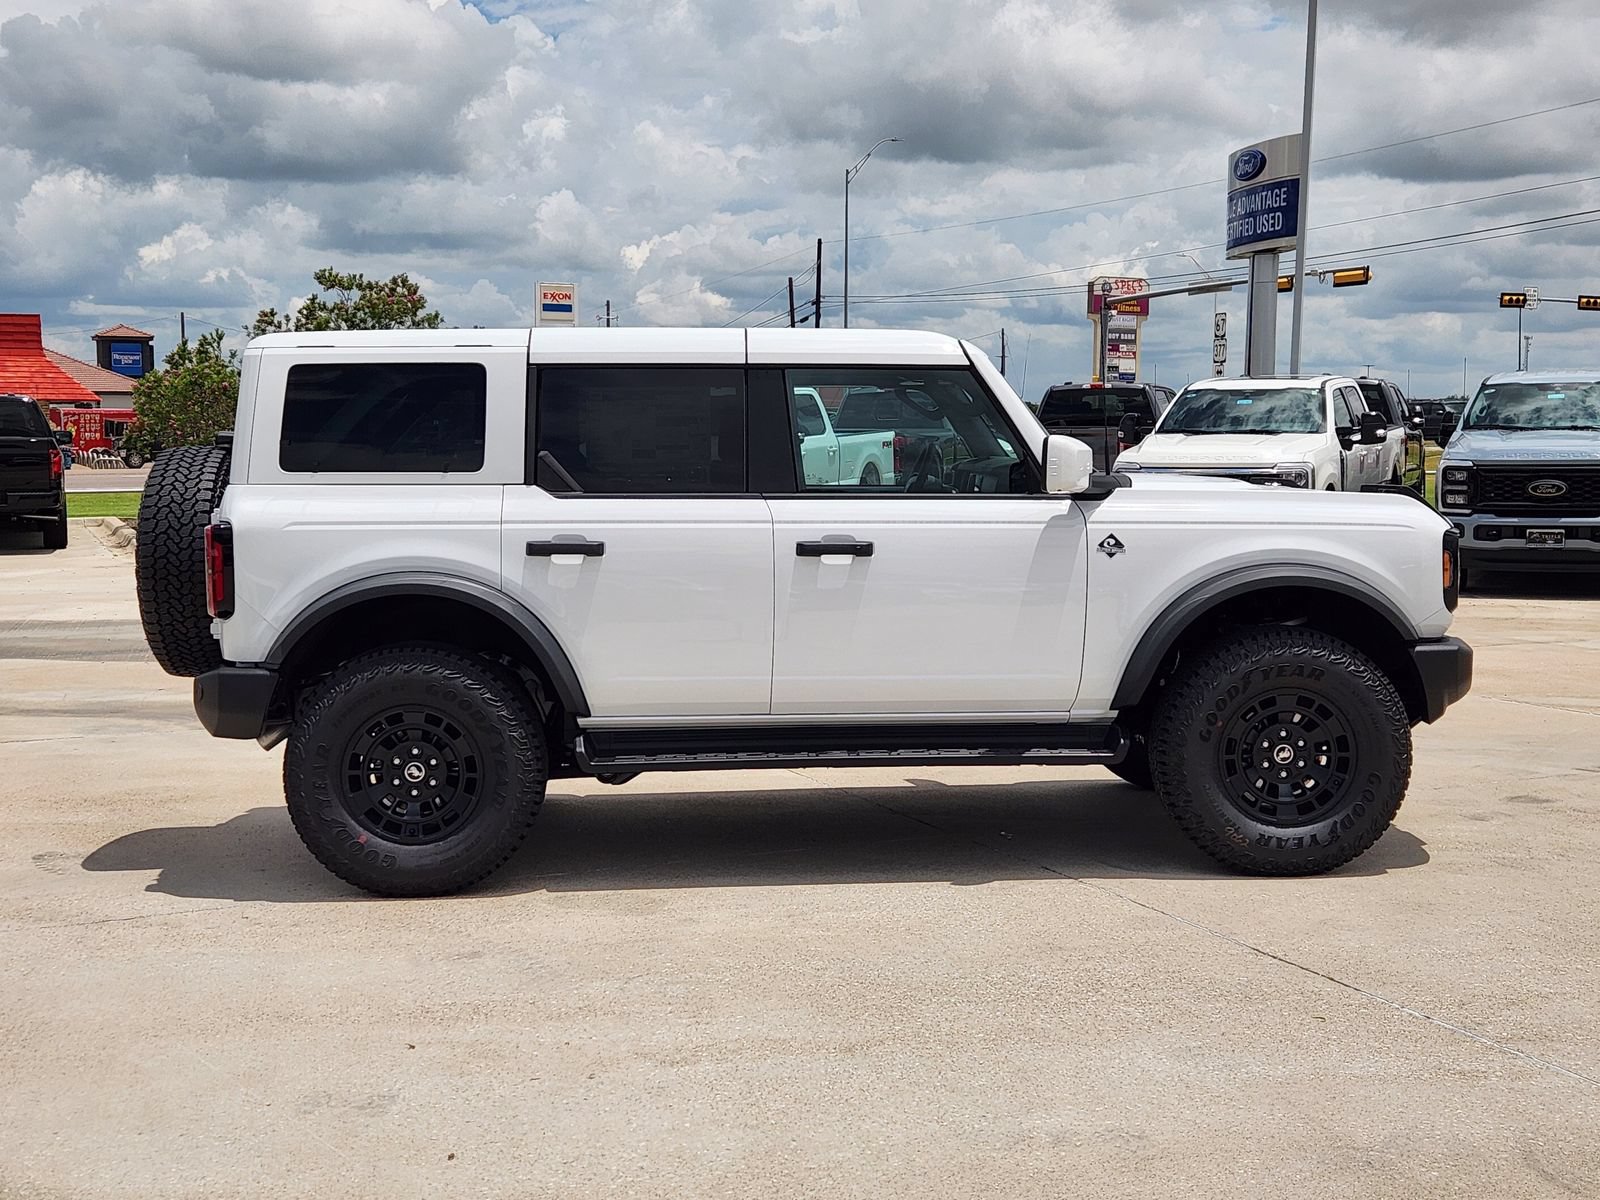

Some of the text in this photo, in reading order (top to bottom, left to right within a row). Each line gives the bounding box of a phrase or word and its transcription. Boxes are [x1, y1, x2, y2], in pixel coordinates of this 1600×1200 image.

[1236, 155, 1255, 177] Ford
[1236, 187, 1288, 217] ADVANTAGE
[1256, 211, 1283, 235] USED
[543, 291, 572, 303] EXXON
[1215, 318, 1226, 332] 67
[1214, 343, 1226, 358] 377
[1537, 484, 1558, 493] Ford
